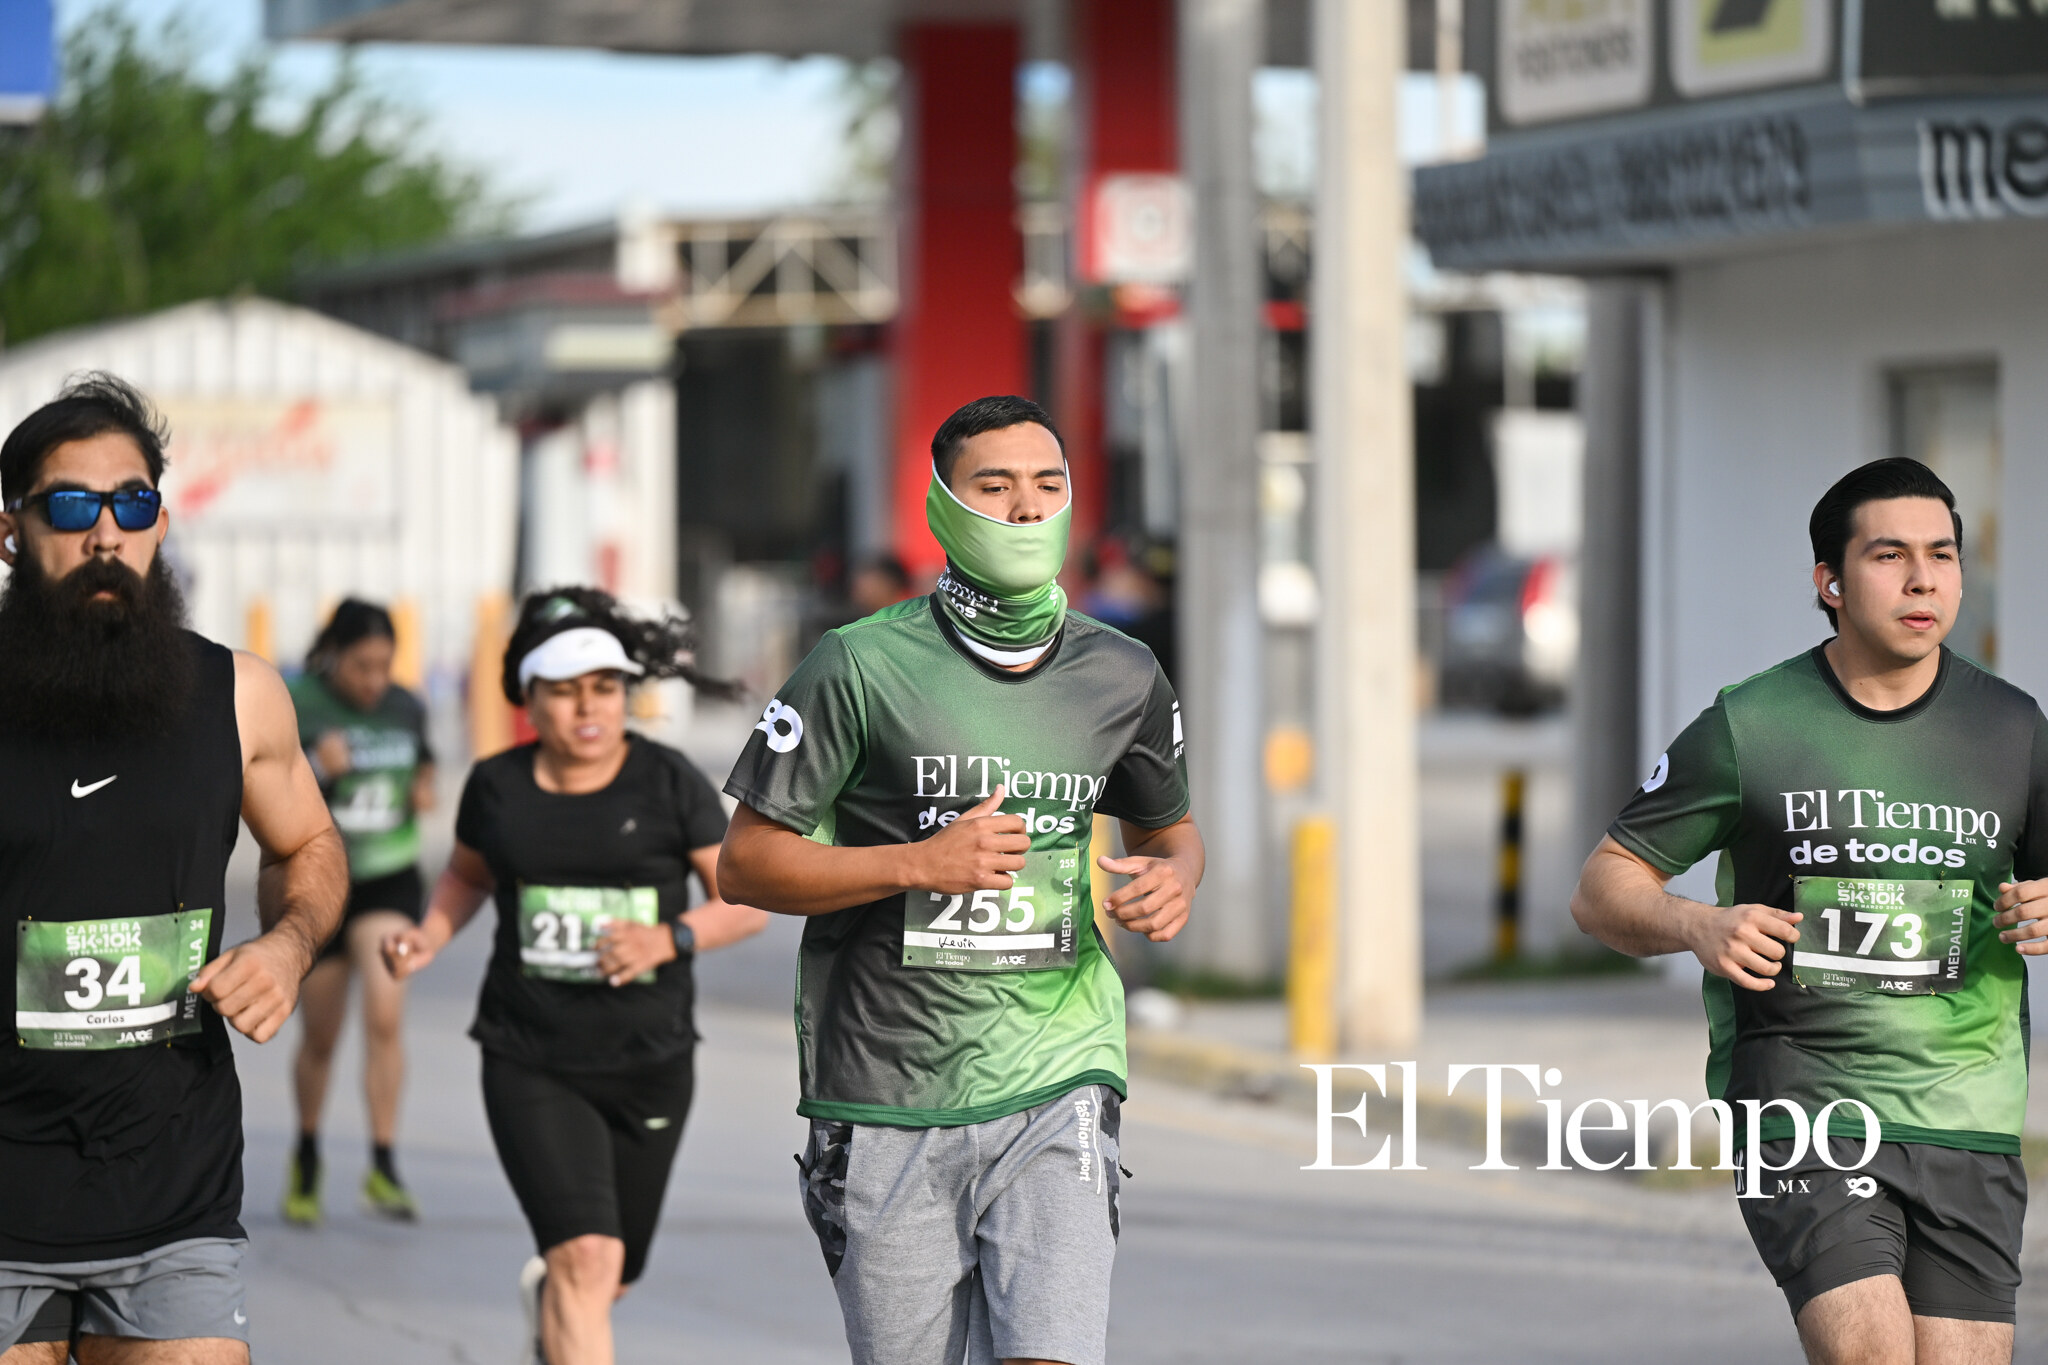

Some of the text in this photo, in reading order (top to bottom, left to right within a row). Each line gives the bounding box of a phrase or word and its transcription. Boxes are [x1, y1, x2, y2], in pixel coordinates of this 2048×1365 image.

[911, 755, 1107, 812] El Tiempo
[1779, 789, 2001, 845] El Tiempo
[1059, 858, 1076, 869] 255
[1789, 838, 1967, 868] de todos
[927, 886, 1036, 933] 255
[1837, 881, 1905, 892] CARRERA
[1951, 888, 1969, 898] 173
[65, 921, 142, 935] CARRERA
[189, 919, 204, 931] 34
[1060, 876, 1074, 953] MEDALLA
[1820, 908, 1923, 959] 173
[938, 936, 977, 949] Kevin
[1946, 906, 1965, 979] MEDALLA
[64, 955, 146, 1011] 34
[183, 938, 203, 1019] MEALLA
[86, 1014, 125, 1025] Carlos
[1074, 1099, 1093, 1182] fashion sport
